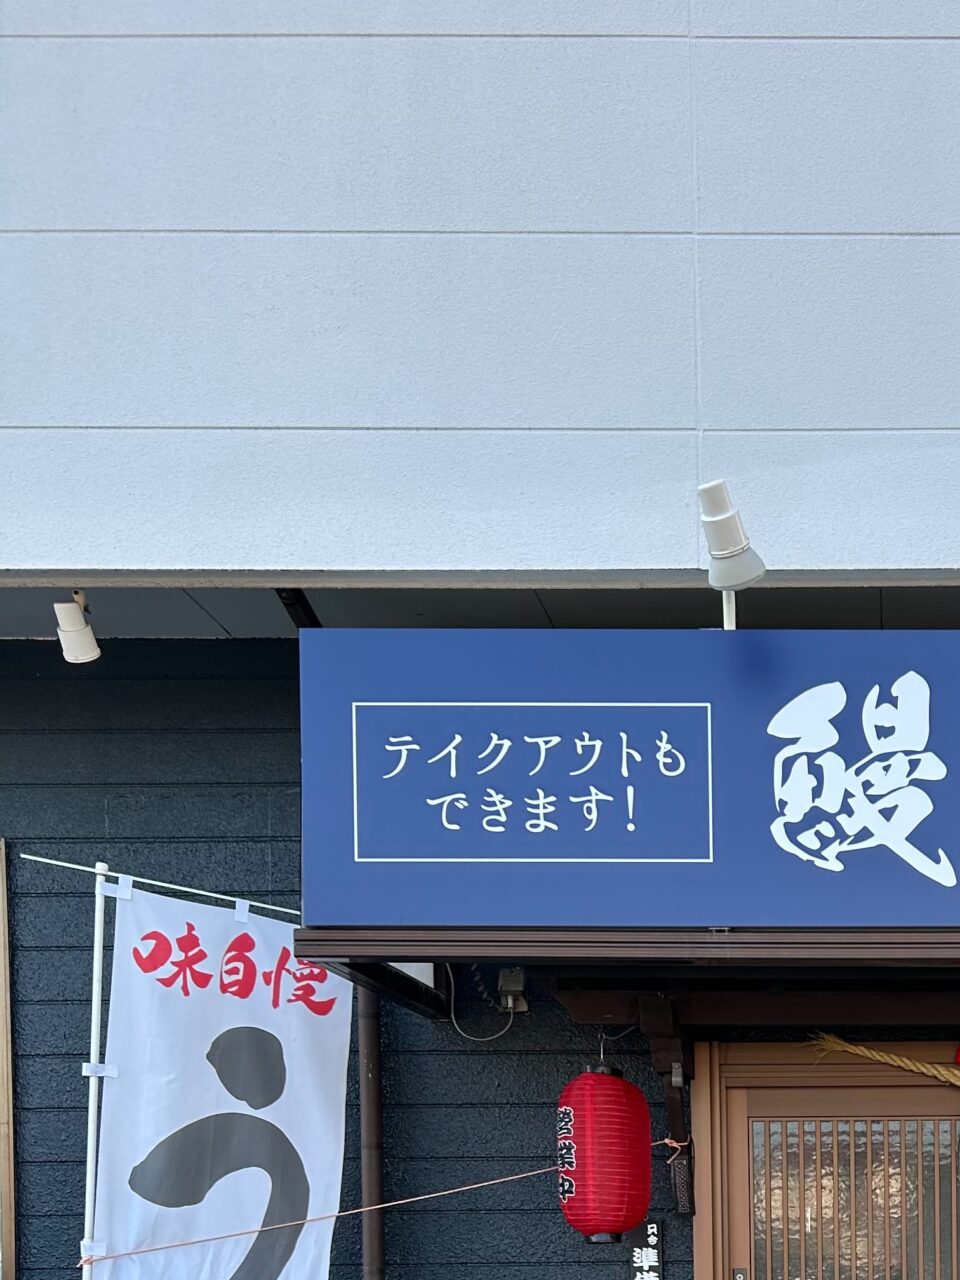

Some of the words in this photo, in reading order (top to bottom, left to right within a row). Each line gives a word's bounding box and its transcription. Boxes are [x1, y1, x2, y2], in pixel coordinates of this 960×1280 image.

[382, 731, 686, 780] テイクアウトも
[132, 922, 338, 1016] 味自慢
